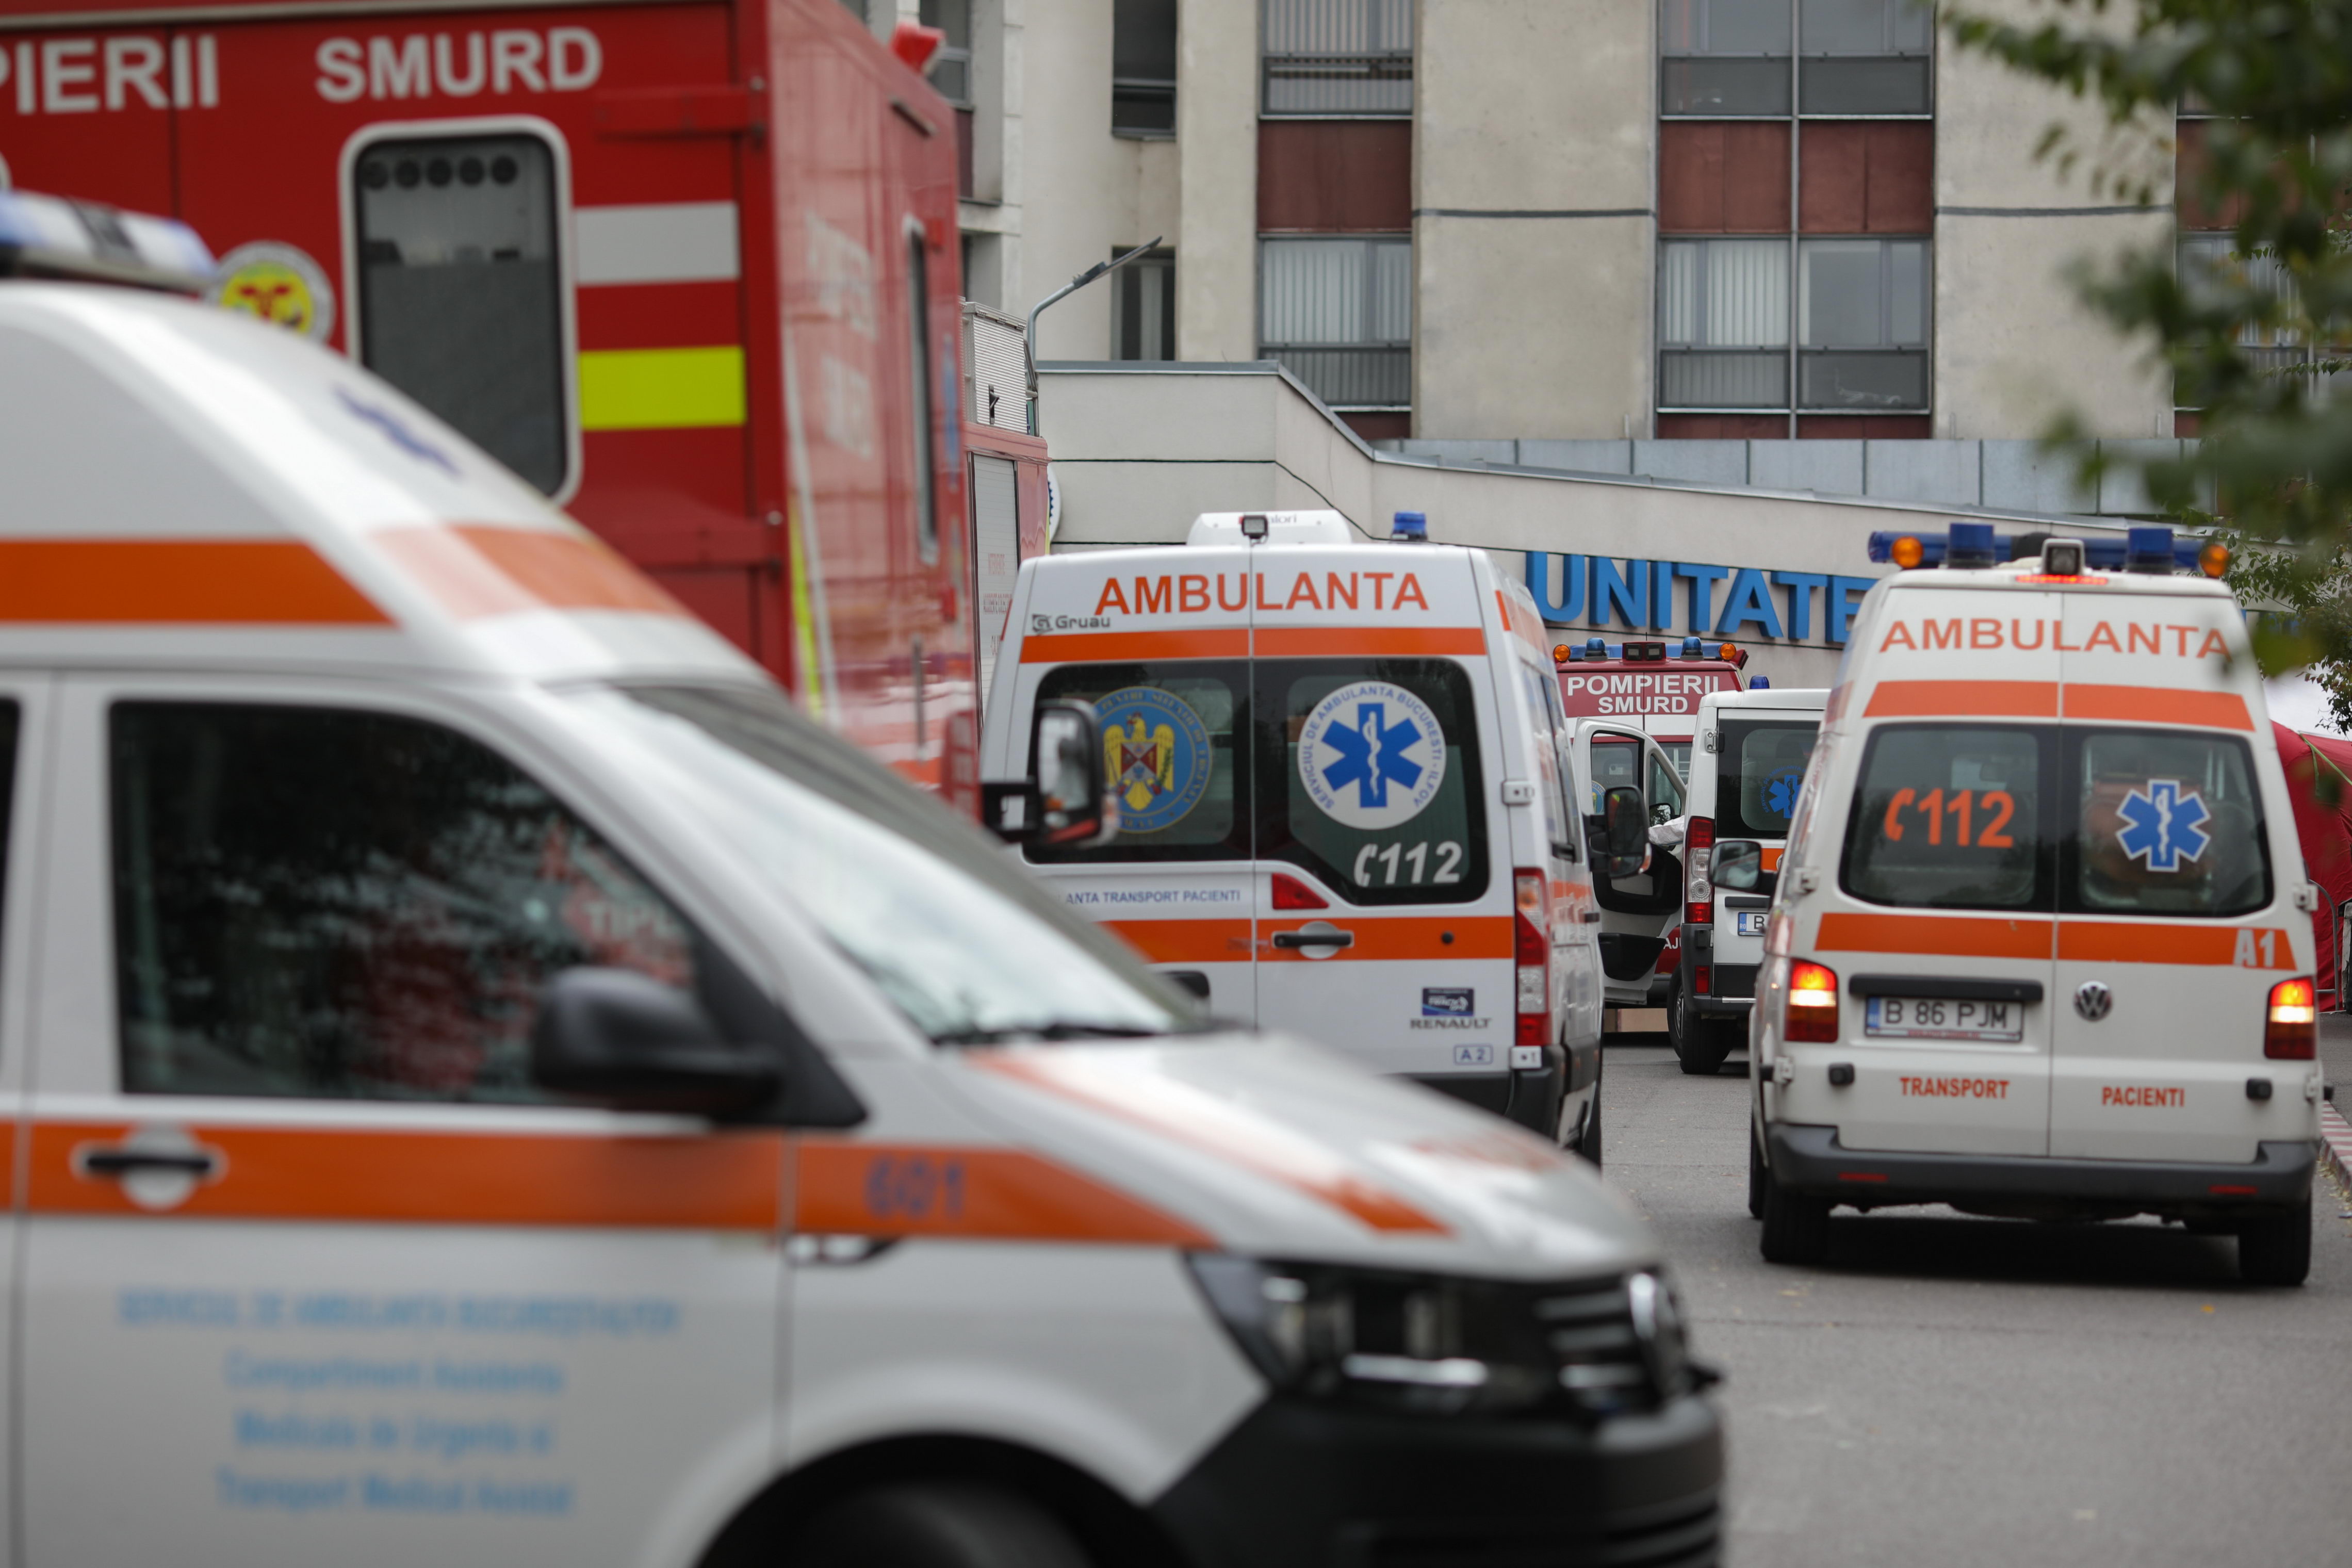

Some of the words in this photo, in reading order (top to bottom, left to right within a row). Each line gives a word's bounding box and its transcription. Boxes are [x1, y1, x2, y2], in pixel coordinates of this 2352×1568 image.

[316, 28, 603, 102] SMURD
[1095, 572, 1429, 616] AMBULANTA
[1525, 551, 1880, 643] UNITATE
[1055, 616, 1111, 630] Gruau
[1880, 618, 2231, 659] AMBULANTA
[1566, 674, 1719, 696] POMPIERII
[1317, 685, 1394, 721] AMBULANTA
[1597, 696, 1689, 714] SMURD
[1305, 721, 1318, 740] DE
[1397, 691, 1441, 761] BUCURESTI
[1303, 741, 1335, 810] SERVICIUL
[1413, 767, 1440, 809] ILFOV
[1918, 789, 2015, 848] 112
[1379, 841, 1463, 885] 112
[1066, 892, 1100, 905] ANTA
[1103, 890, 1179, 903] TRANSPORT
[1183, 890, 1240, 902] PACIENTI
[1754, 916, 1765, 929] B
[1663, 937, 1681, 949] AJ
[2233, 929, 2275, 969] A1
[1410, 1018, 1491, 1029] RENAULT
[1885, 1000, 1903, 1024] B
[1916, 1001, 1945, 1025] 86
[1957, 1003, 2007, 1028] PJM
[1900, 1077, 2010, 1099] TRANSPORT
[2102, 1086, 2185, 1107] PACIENTI
